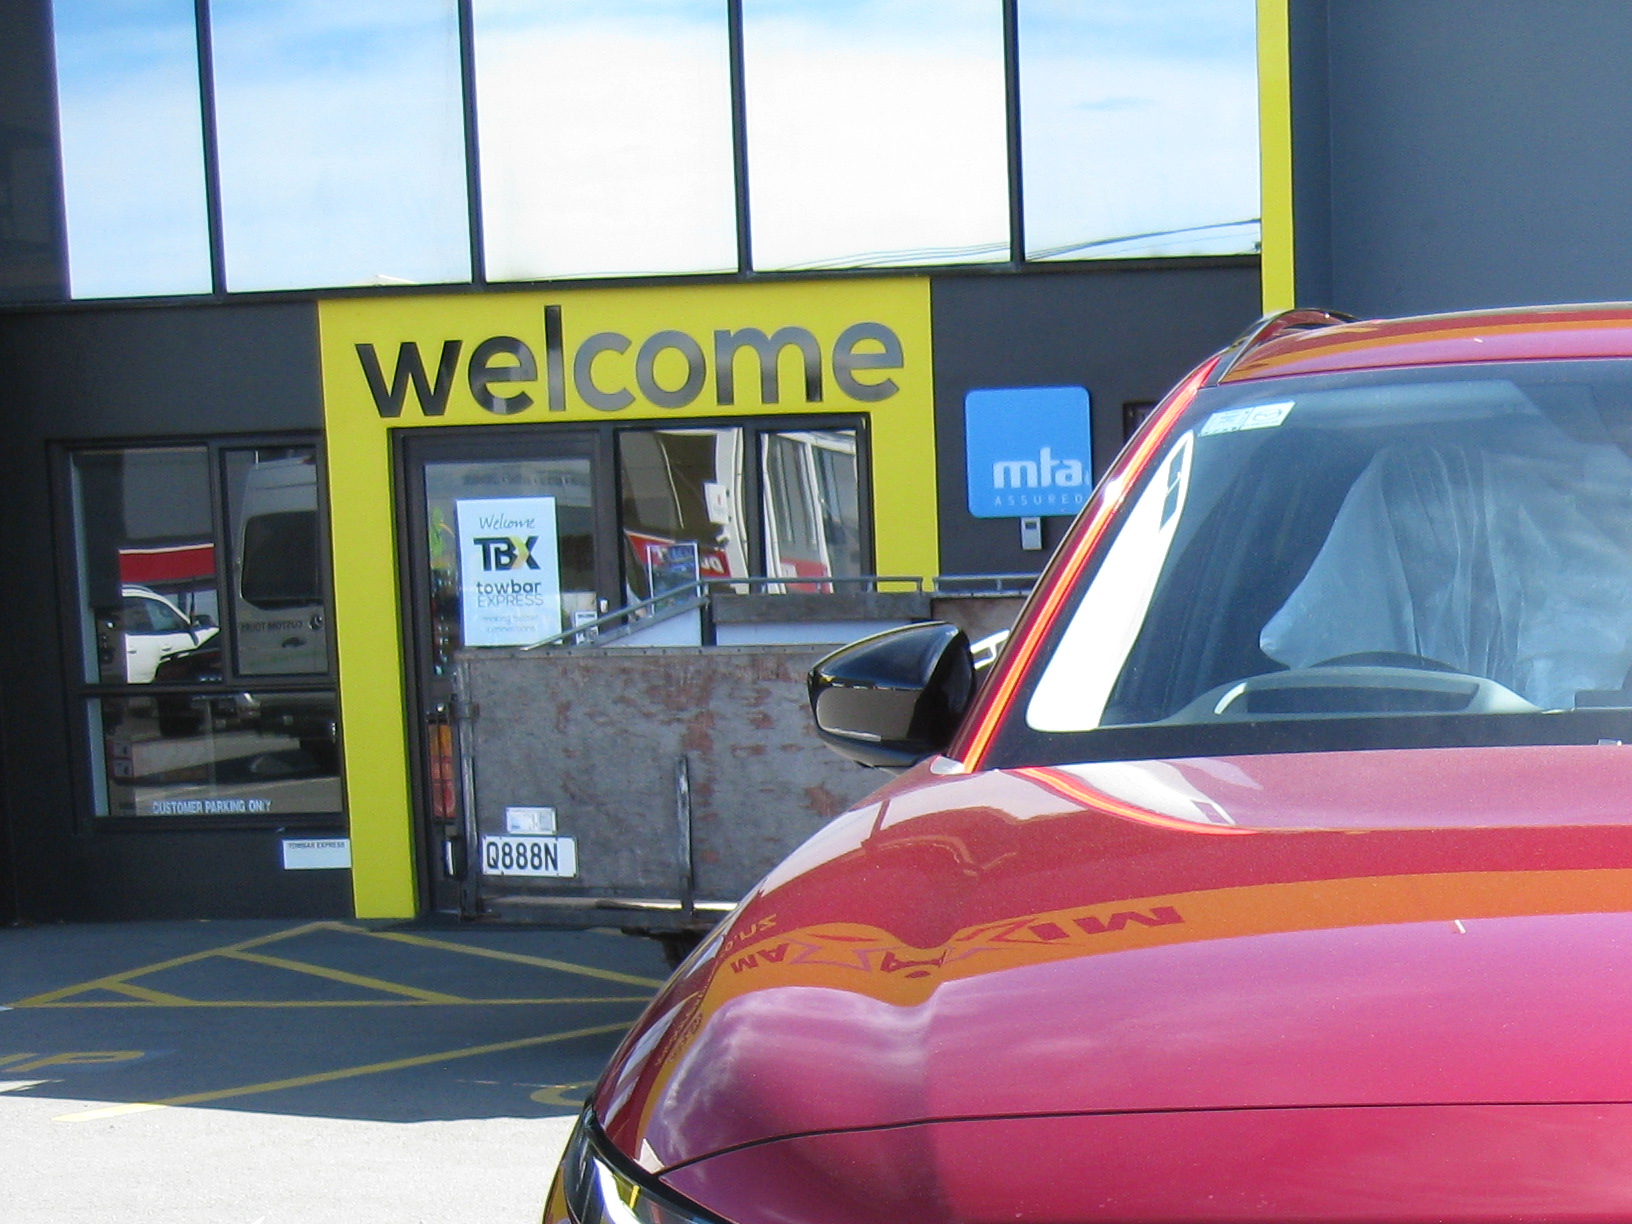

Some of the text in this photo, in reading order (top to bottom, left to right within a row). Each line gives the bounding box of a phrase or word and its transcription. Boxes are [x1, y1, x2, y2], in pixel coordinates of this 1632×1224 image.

[355, 304, 904, 418] welcome
[993, 447, 1083, 489] mta
[994, 494, 1083, 507] ASSURED
[479, 513, 536, 530] Welcome
[473, 535, 542, 572] TBX
[476, 579, 541, 595] towbar
[477, 593, 544, 608] EXPRESS
[153, 799, 272, 814] CUSTOMER PARKING ONLY
[486, 841, 558, 871] Q888N
